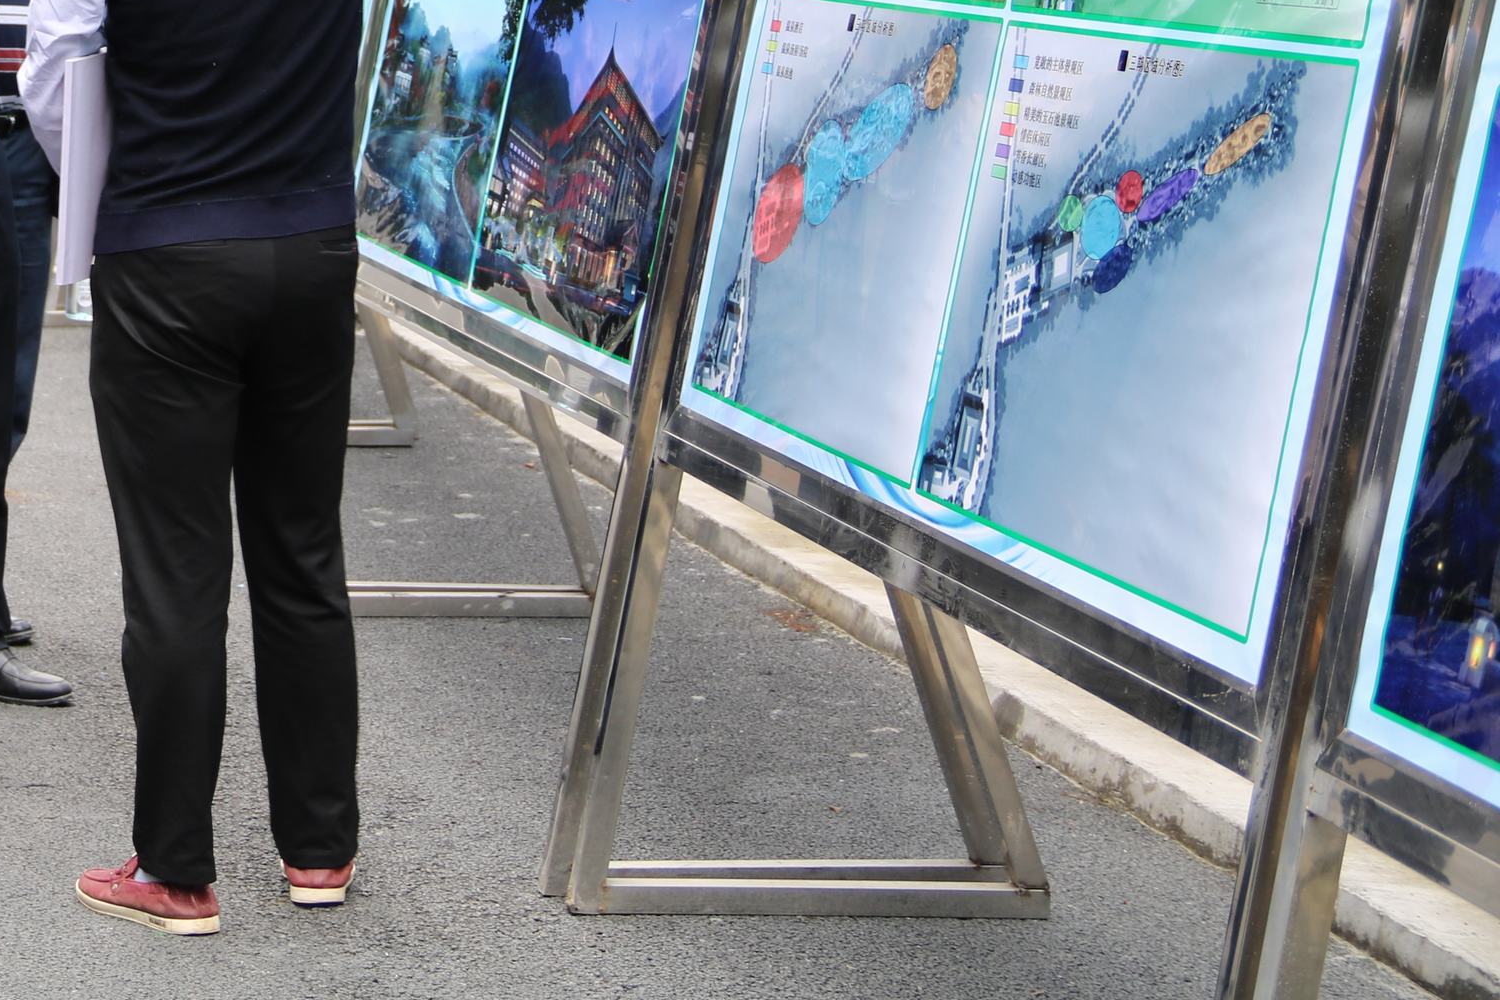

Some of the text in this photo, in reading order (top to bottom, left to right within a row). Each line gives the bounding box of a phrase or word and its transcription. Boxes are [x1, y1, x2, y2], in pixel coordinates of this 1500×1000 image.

[1029, 82, 1074, 101] 森林自然景观区
